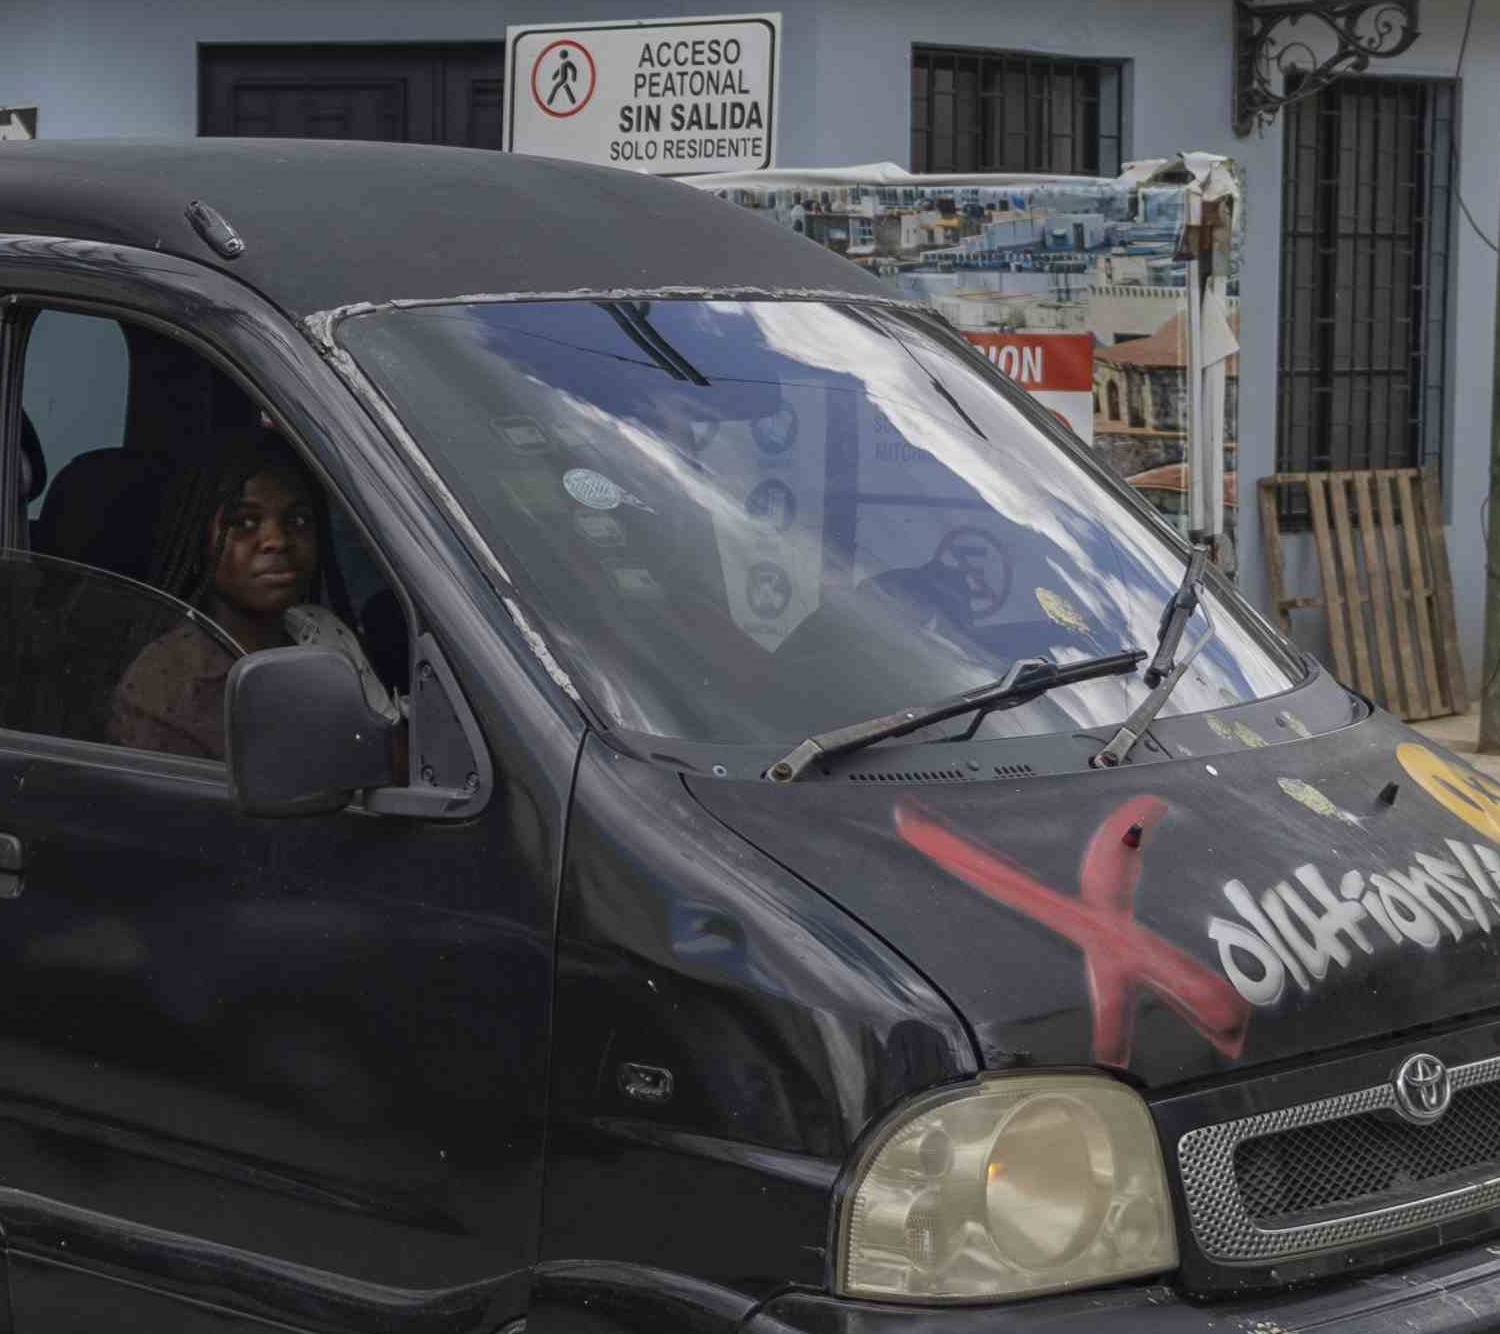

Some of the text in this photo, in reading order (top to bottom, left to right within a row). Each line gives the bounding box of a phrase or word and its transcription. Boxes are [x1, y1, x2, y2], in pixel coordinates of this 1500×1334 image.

[638, 38, 741, 68] ACCESO
[634, 69, 750, 98] PEATONAL
[619, 101, 763, 133] SIN SALIDA
[609, 137, 763, 161] SOLO RESIDENTE
[972, 345, 1043, 384] ION
